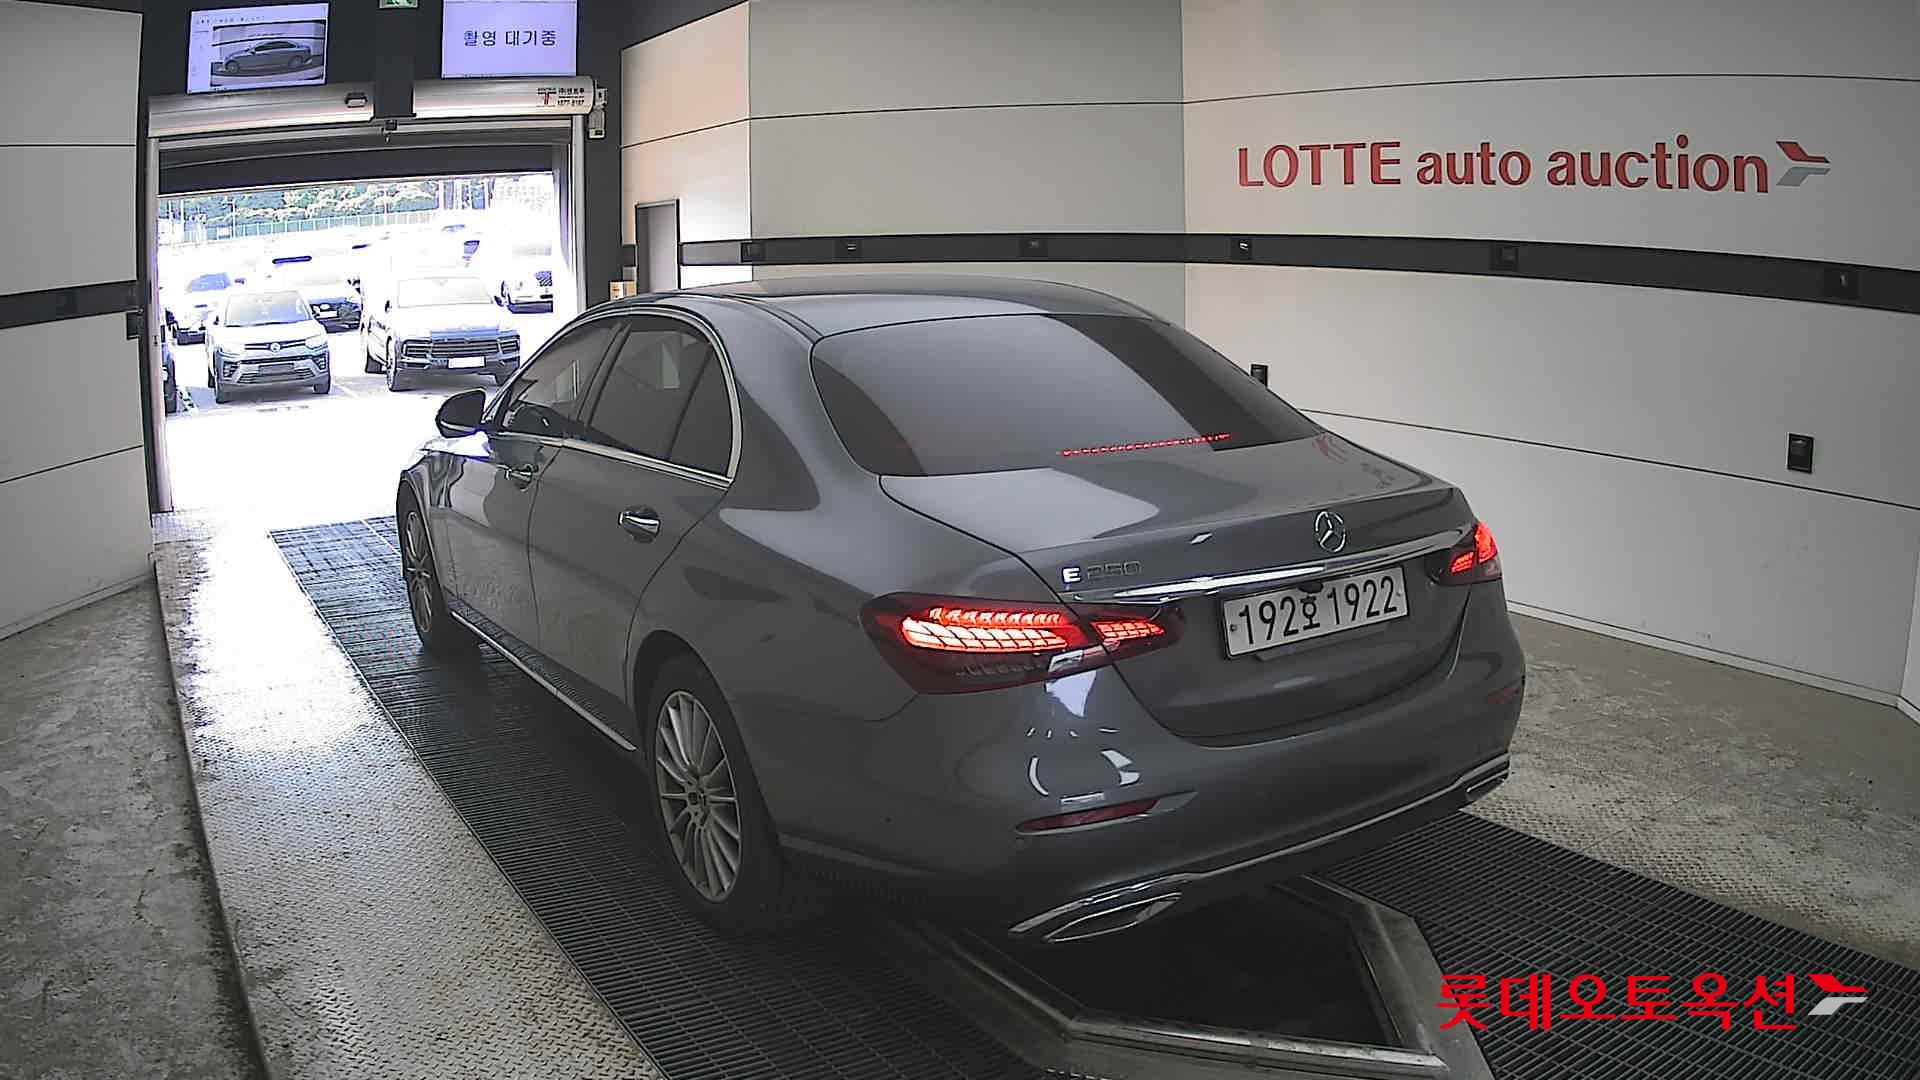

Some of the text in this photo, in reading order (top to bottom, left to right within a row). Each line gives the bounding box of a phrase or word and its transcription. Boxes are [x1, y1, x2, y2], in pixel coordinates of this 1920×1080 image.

[464, 29, 557, 47] 촬영 대기중
[1238, 133, 1769, 194] LOTTE auto auction
[1062, 560, 1141, 583] E 250
